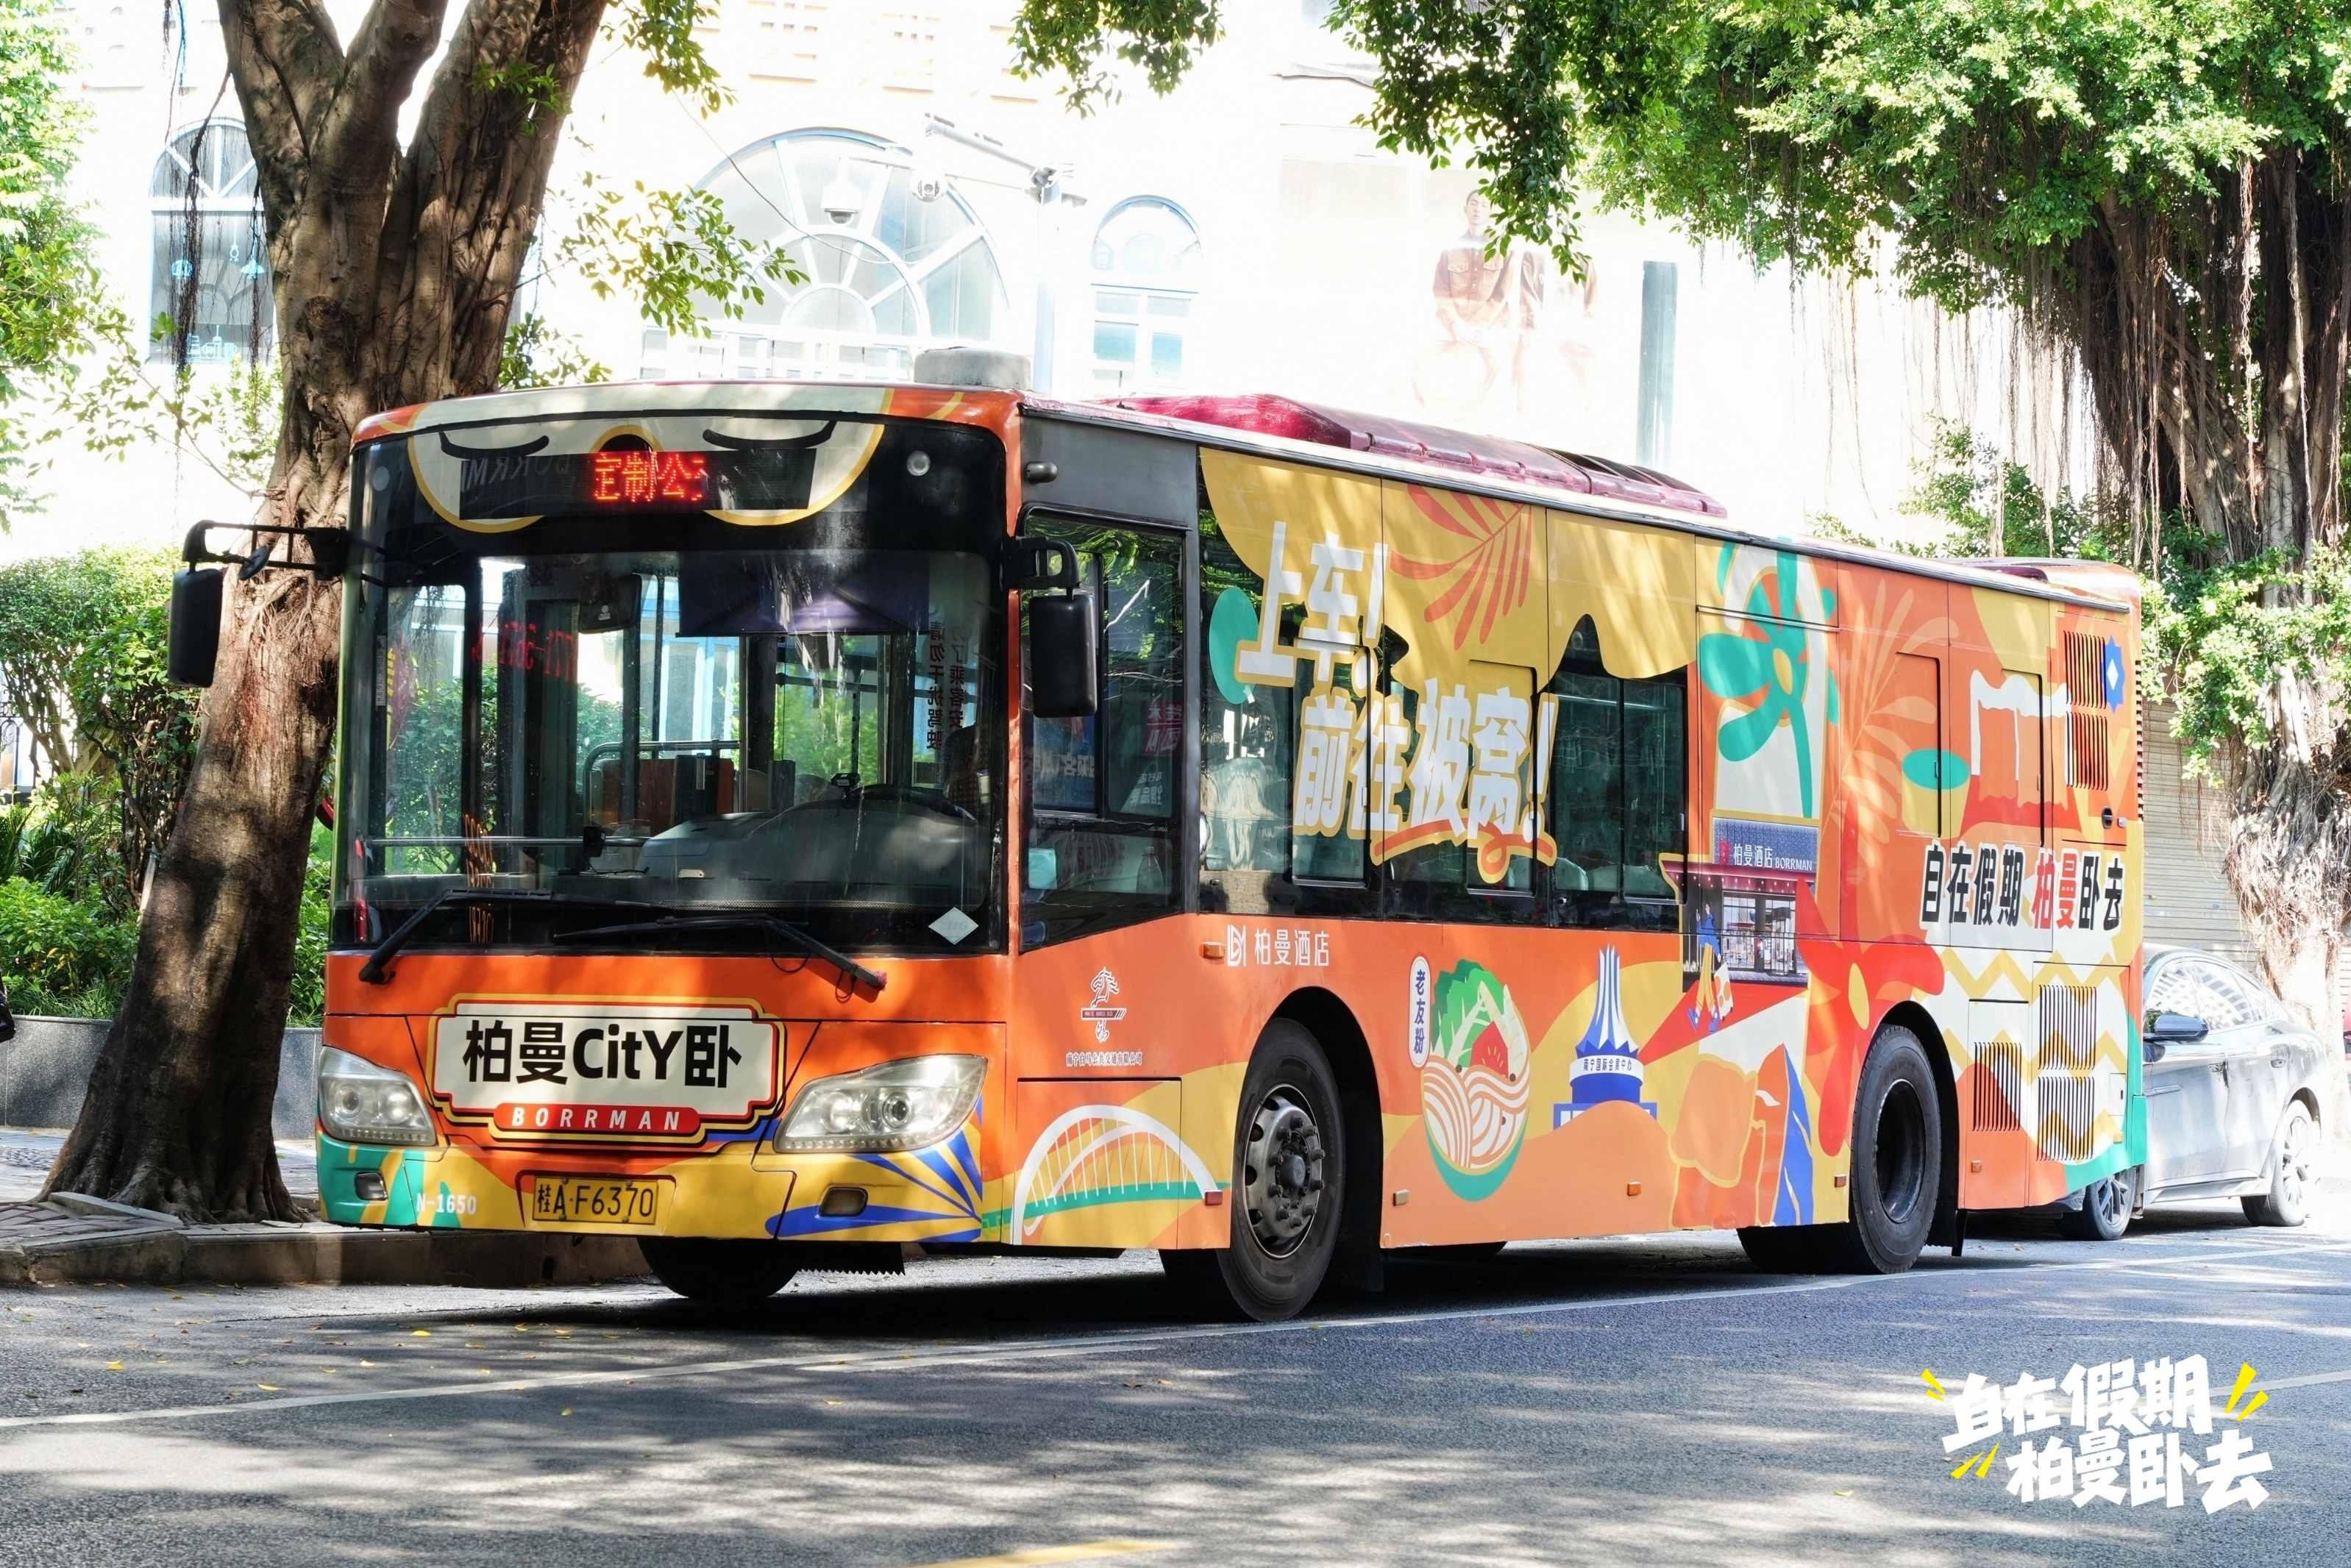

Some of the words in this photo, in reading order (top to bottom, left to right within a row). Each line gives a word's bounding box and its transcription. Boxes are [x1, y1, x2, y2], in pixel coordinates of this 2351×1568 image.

[1733, 844, 1773, 868] 柏曼酒店
[1775, 857, 1813, 871] BORRMAN
[1921, 844, 2023, 927] 自在假期
[2031, 848, 2124, 931] 柏曼卧去
[1253, 927, 1330, 966] 柏曼酒店
[1414, 969, 1426, 1054] 老友粉
[462, 1019, 741, 1088] 柏曼CitY卧
[511, 1108, 681, 1131] BORRMAN
[416, 1192, 477, 1215] N-1650
